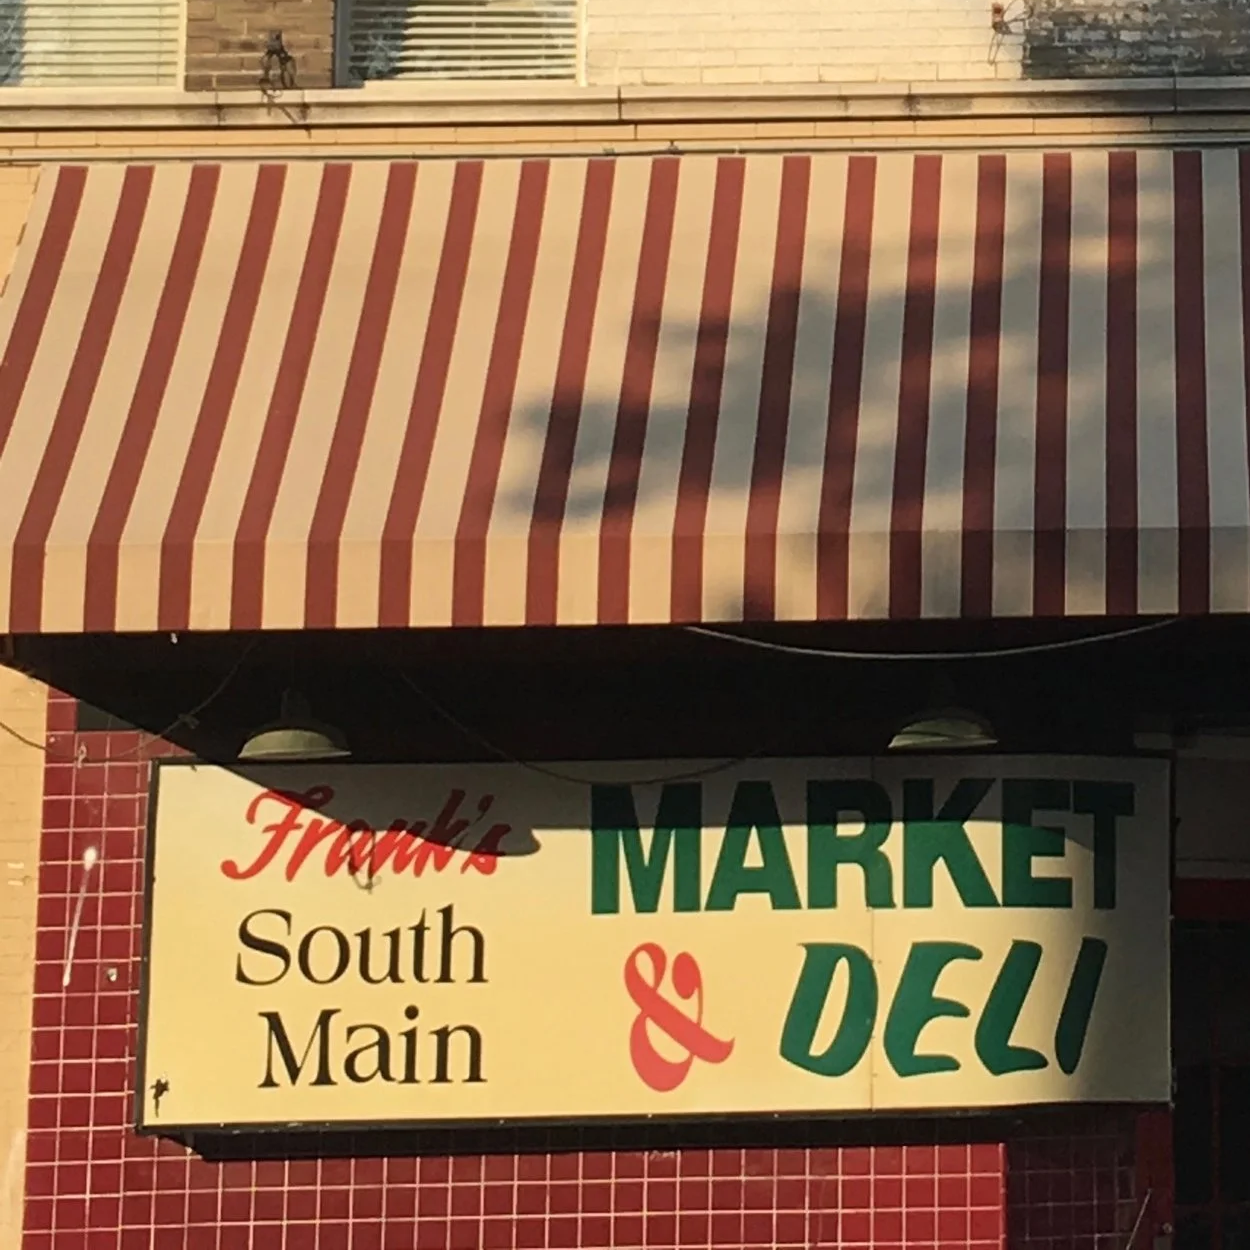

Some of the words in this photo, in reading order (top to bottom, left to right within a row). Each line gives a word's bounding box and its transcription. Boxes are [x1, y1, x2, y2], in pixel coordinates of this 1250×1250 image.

[220, 785, 511, 883] Frank's
[590, 777, 1135, 915] MARKET
[235, 903, 489, 986] South
[257, 1003, 488, 1089] Main
[623, 941, 736, 1093] &
[779, 936, 1109, 1078] DELI
